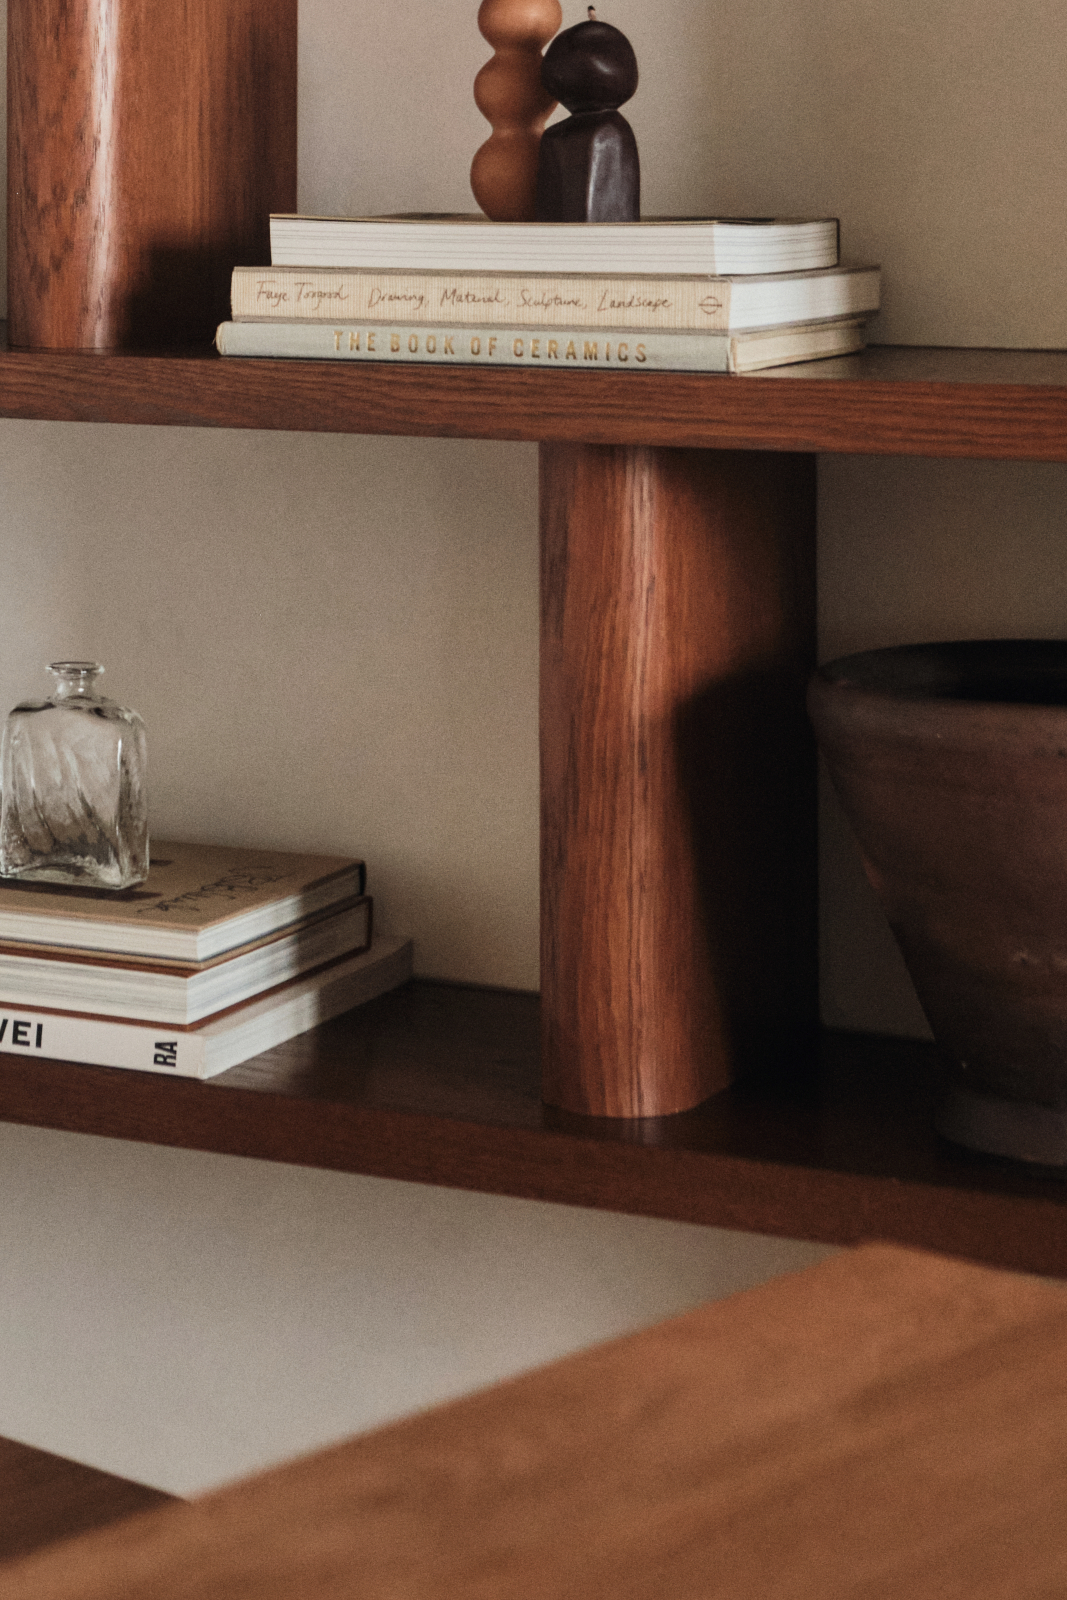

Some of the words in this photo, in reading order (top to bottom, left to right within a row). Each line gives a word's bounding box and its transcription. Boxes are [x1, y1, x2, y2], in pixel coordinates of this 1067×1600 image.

[256, 280, 289, 307] Faye
[597, 289, 673, 312] Landscape
[334, 331, 376, 352] THE
[390, 334, 455, 355] BOOK
[470, 336, 498, 357] OF
[513, 338, 647, 363] CERAMICS
[153, 1041, 178, 1068] RA
